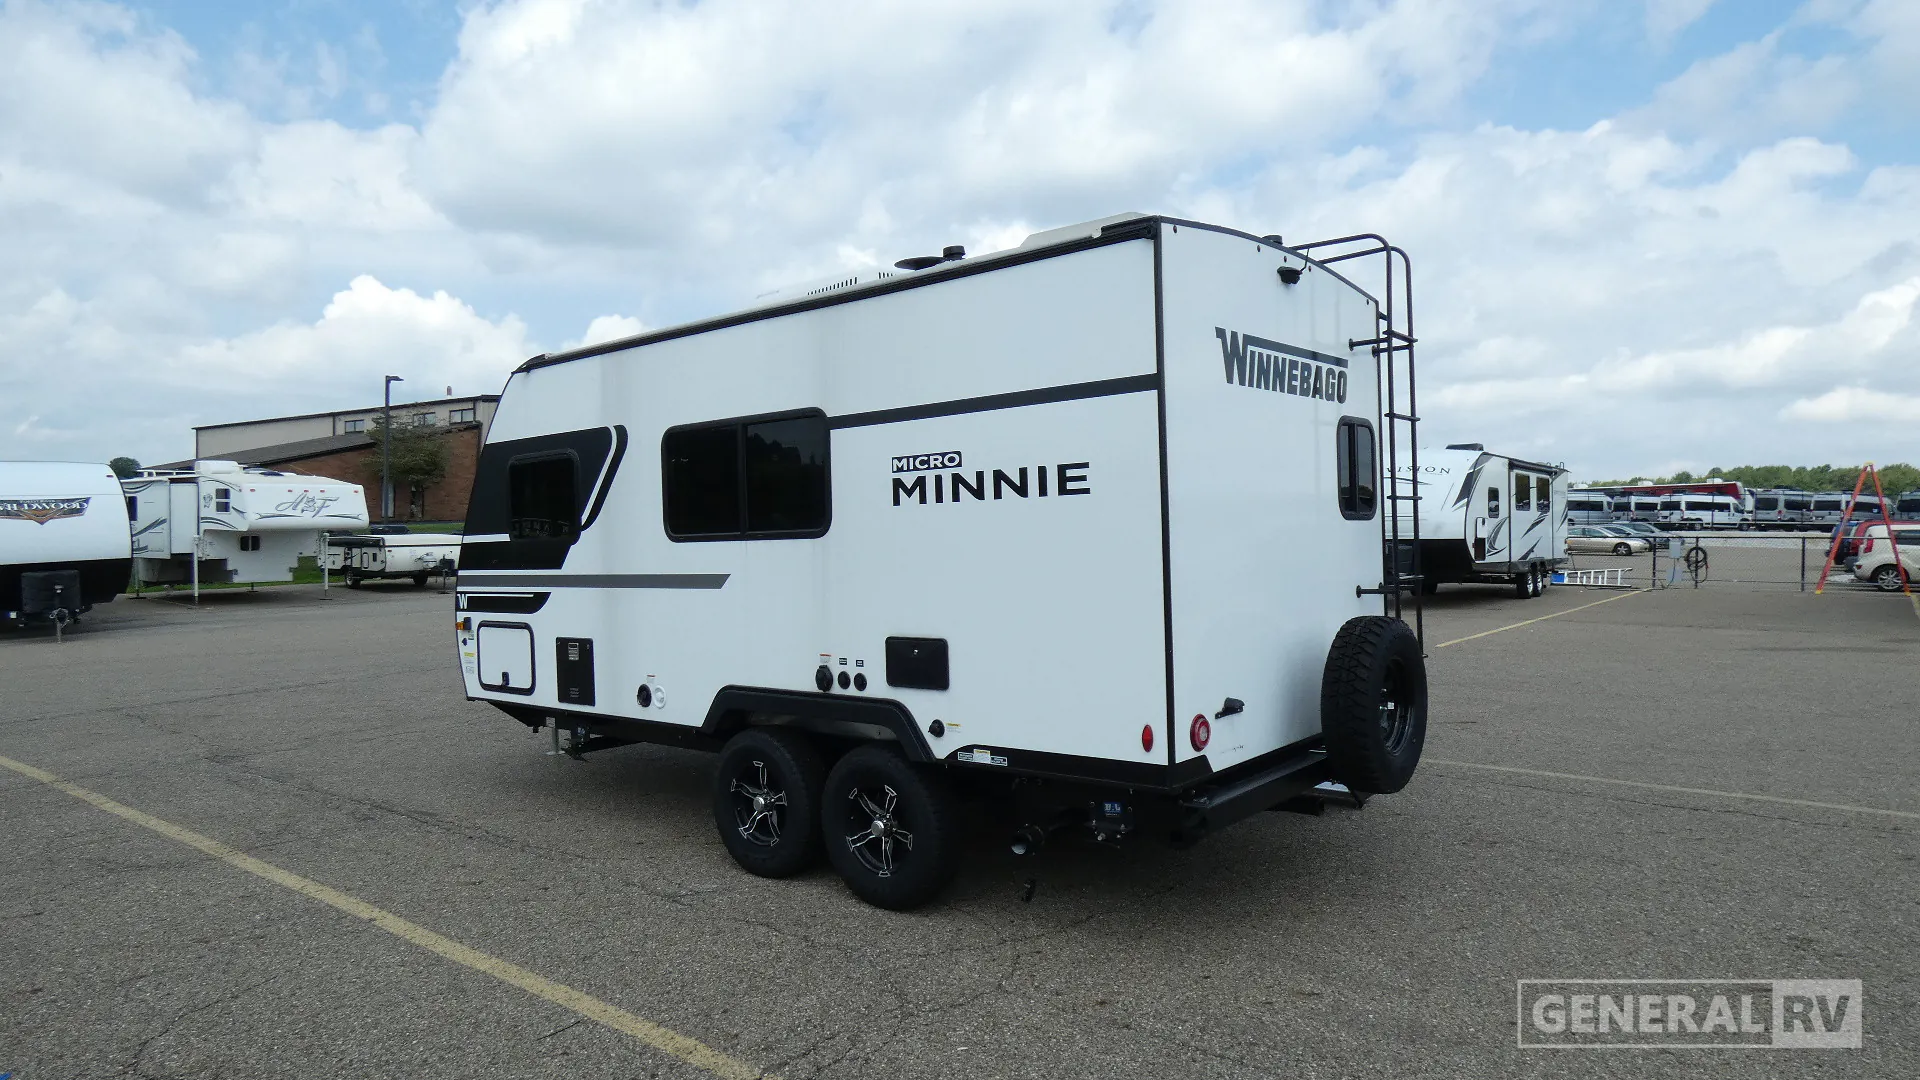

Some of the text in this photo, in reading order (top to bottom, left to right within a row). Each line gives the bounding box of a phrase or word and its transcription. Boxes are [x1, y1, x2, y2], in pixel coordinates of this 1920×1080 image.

[1215, 326, 1349, 404] WINNEBAGO
[892, 452, 960, 471] MICRO
[892, 462, 1090, 506] MINNIE
